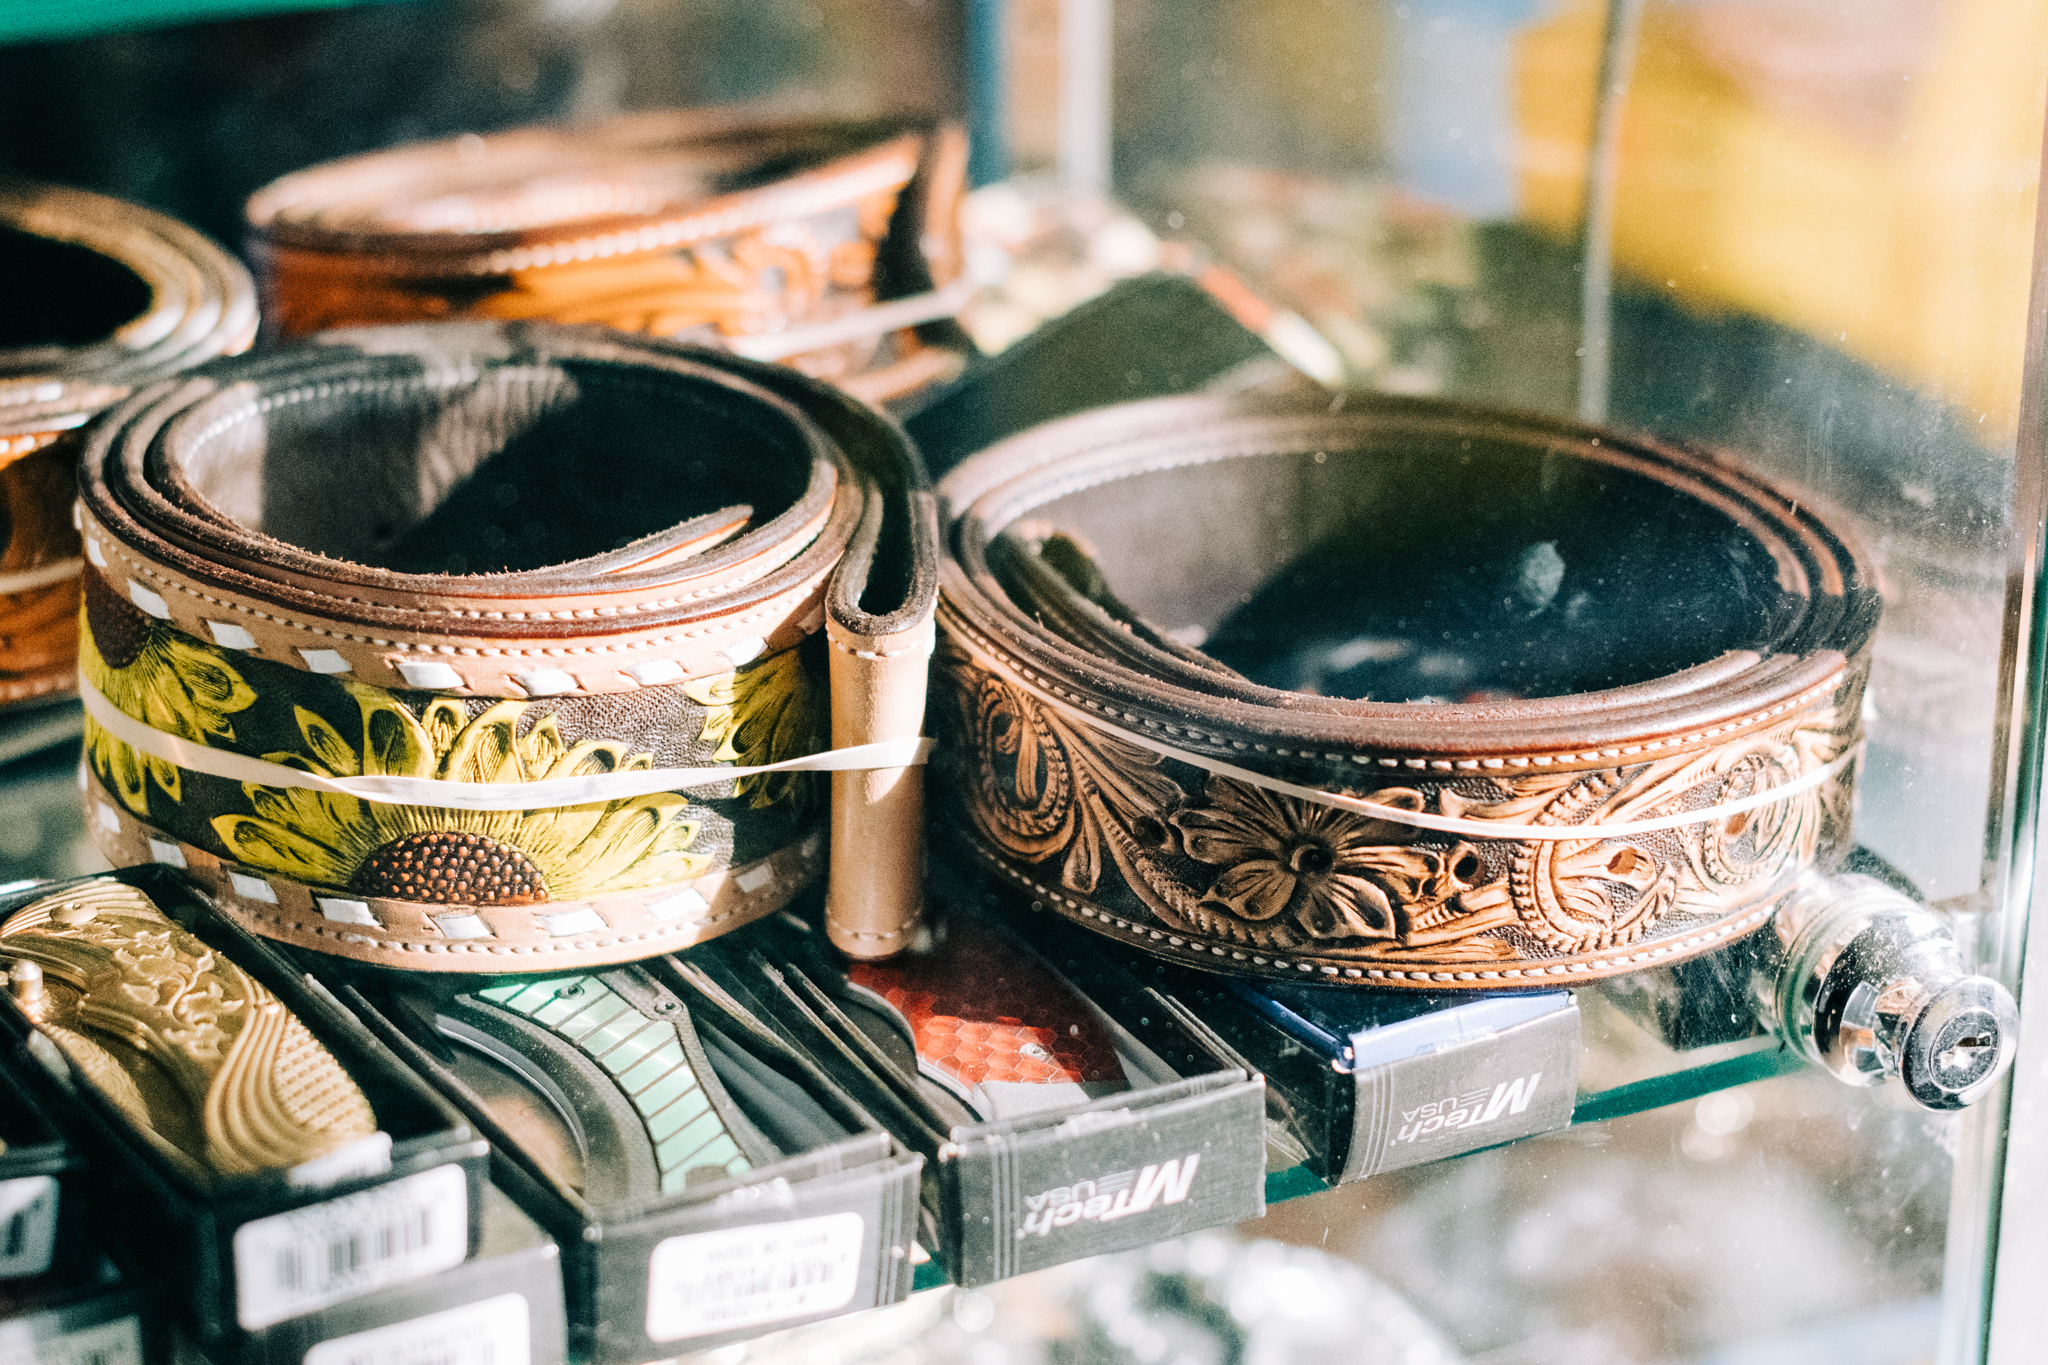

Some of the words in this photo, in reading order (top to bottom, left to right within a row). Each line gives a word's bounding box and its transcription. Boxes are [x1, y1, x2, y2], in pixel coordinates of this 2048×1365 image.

[1396, 1071, 1543, 1143] MTech
[1402, 1097, 1458, 1122] USA
[1022, 1152, 1200, 1237] MTech
[1024, 1179, 1097, 1212] USA
